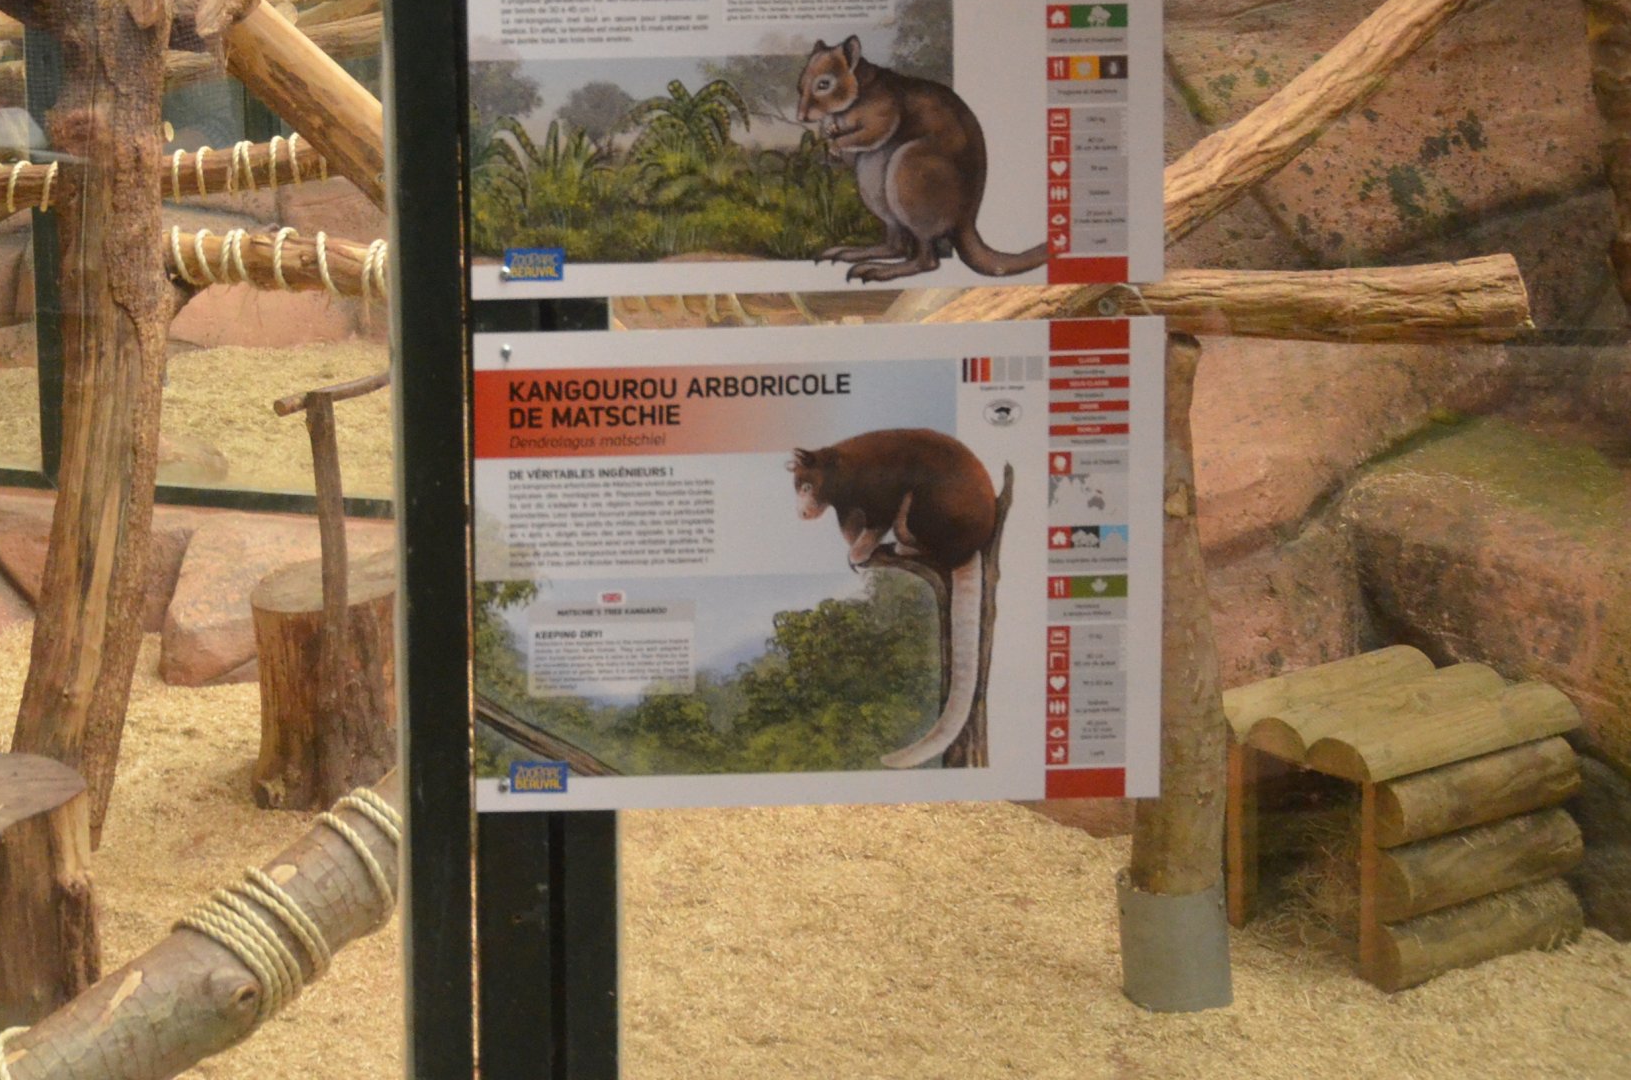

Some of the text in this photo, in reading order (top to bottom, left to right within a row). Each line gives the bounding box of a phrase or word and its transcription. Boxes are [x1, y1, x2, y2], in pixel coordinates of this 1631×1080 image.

[509, 373, 851, 402] KANGOUROU ARBORICOLE
[508, 404, 681, 429] DE MATSCHIE
[510, 432, 667, 450] Dendrolagus matschiei
[509, 470, 524, 480] DE
[527, 468, 595, 480] VÉRITABLES
[598, 467, 667, 478] INGÉNIEURS
[535, 630, 577, 640] KEEPING
